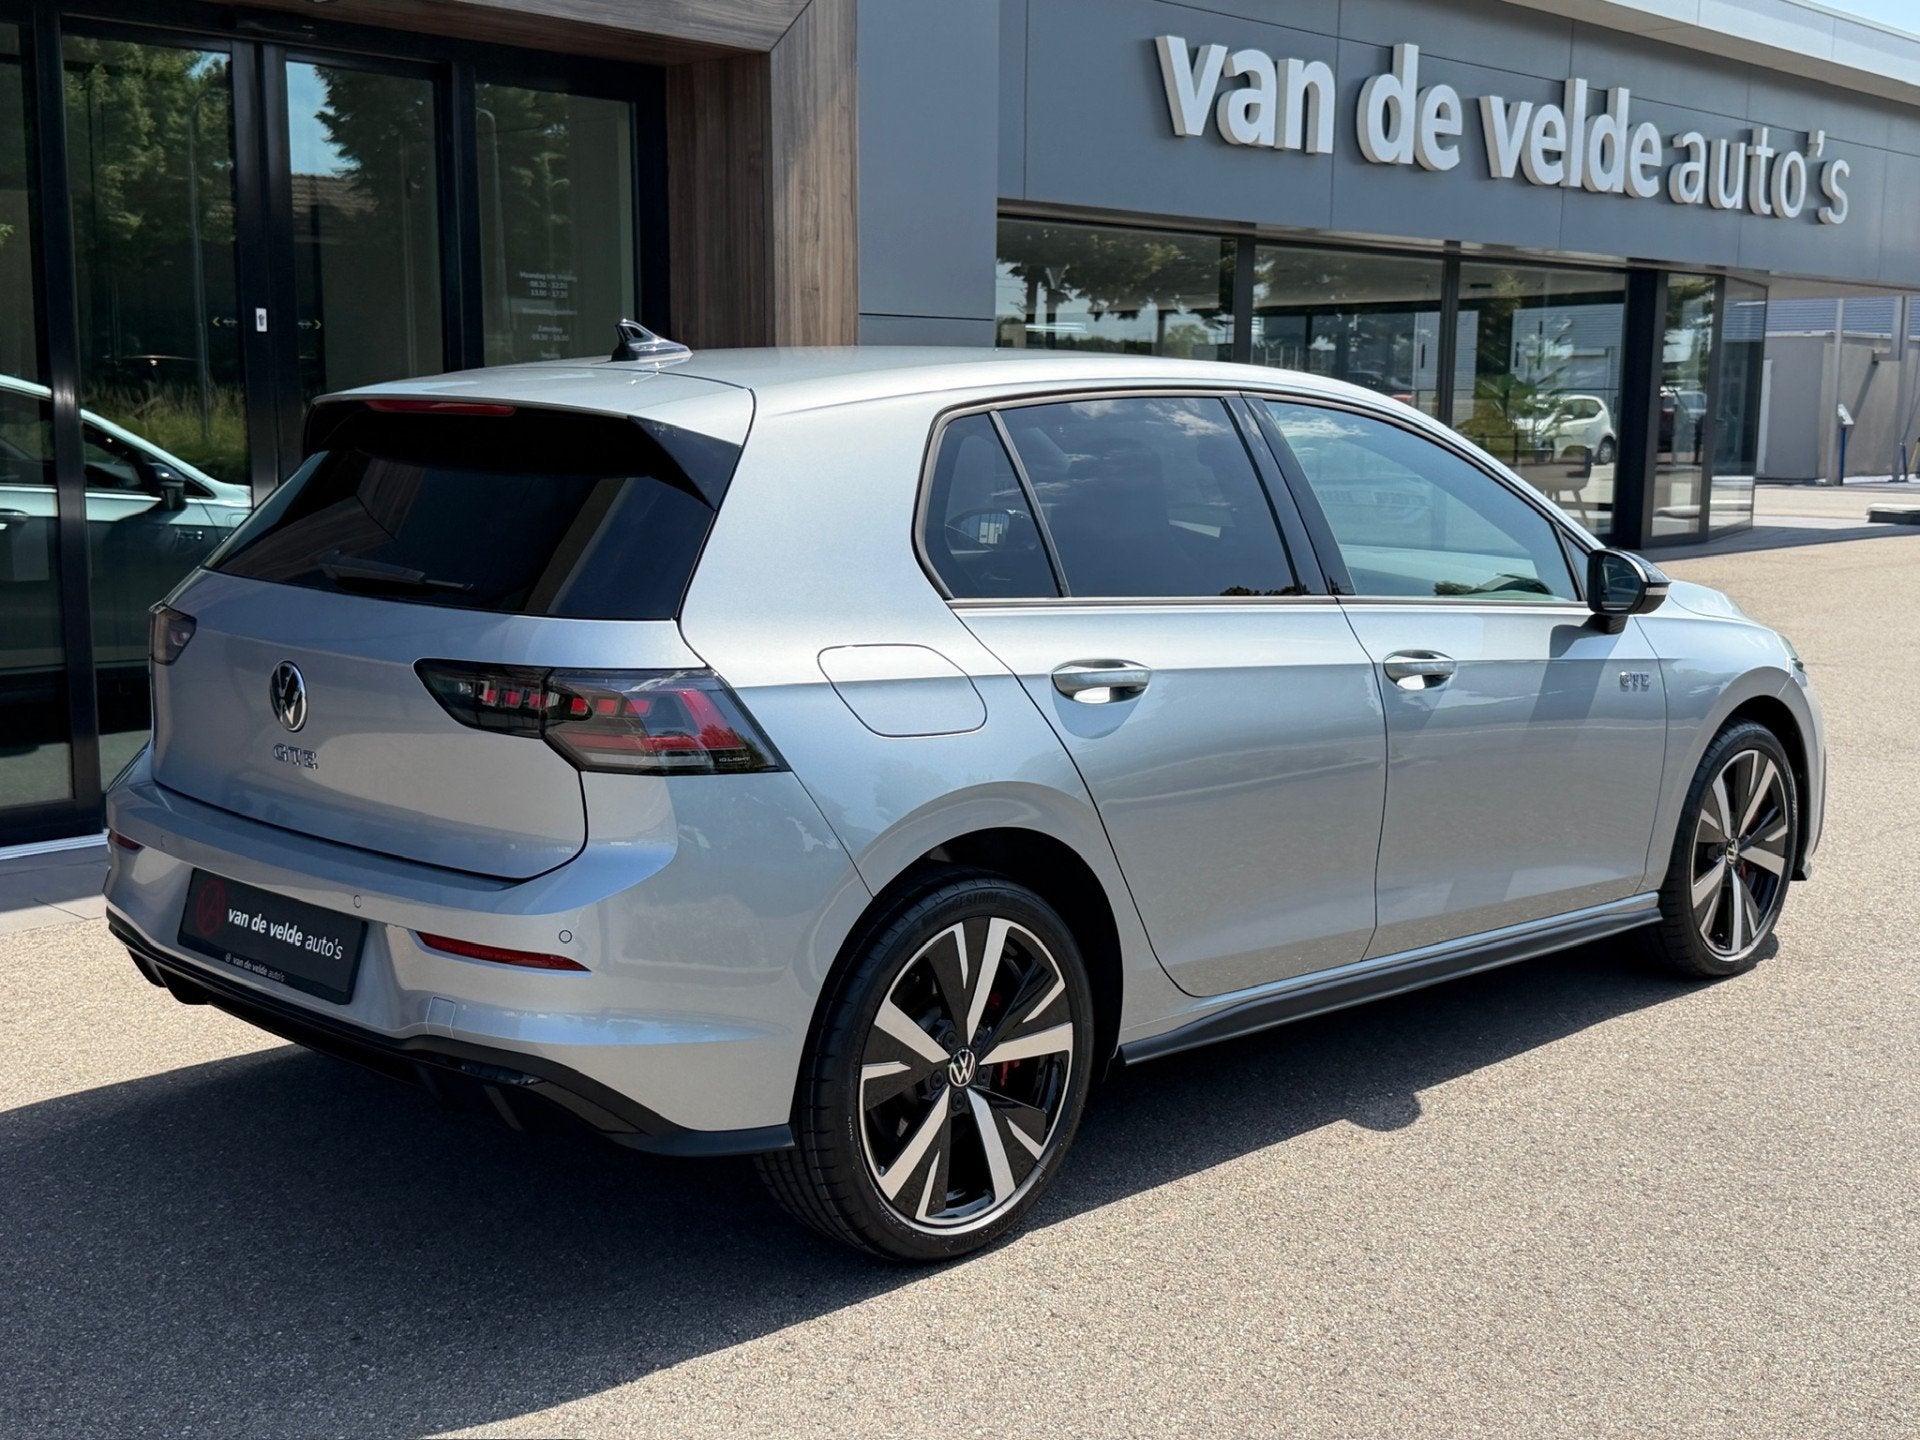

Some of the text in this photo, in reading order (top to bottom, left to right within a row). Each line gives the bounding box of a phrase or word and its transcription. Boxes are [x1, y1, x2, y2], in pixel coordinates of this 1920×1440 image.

[1156, 35, 1850, 225] van de velde auto's
[273, 742, 318, 770] GTE
[228, 908, 344, 960] van de velde auto's
